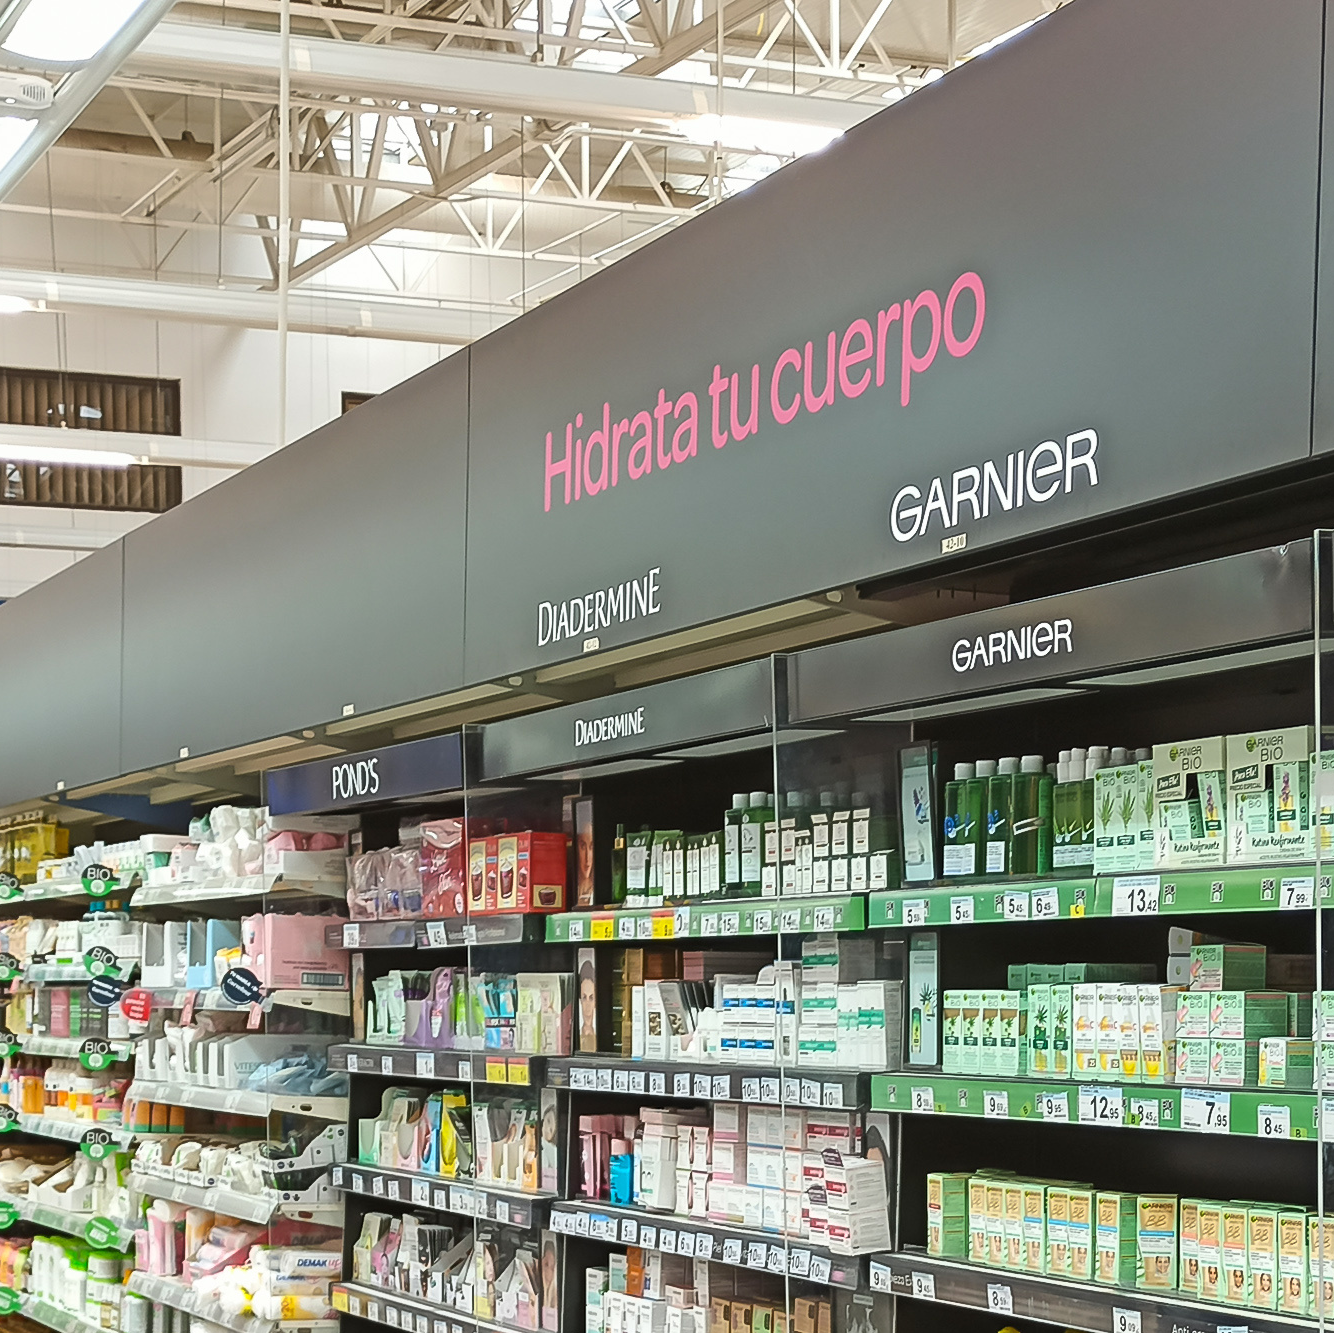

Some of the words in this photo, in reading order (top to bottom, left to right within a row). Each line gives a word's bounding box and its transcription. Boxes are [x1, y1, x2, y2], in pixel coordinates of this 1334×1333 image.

[544, 388, 699, 511] Hidrata
[709, 363, 761, 450] tu
[769, 271, 986, 425] cuerpo
[890, 427, 1100, 543] GARNIER
[537, 567, 662, 648] DIADERMINE
[951, 618, 1074, 673] GARNIER
[575, 706, 645, 746] DIADERMINE
[1261, 747, 1283, 762] BIO
[332, 758, 379, 800] POND'S
[88, 866, 111, 882] BIO
